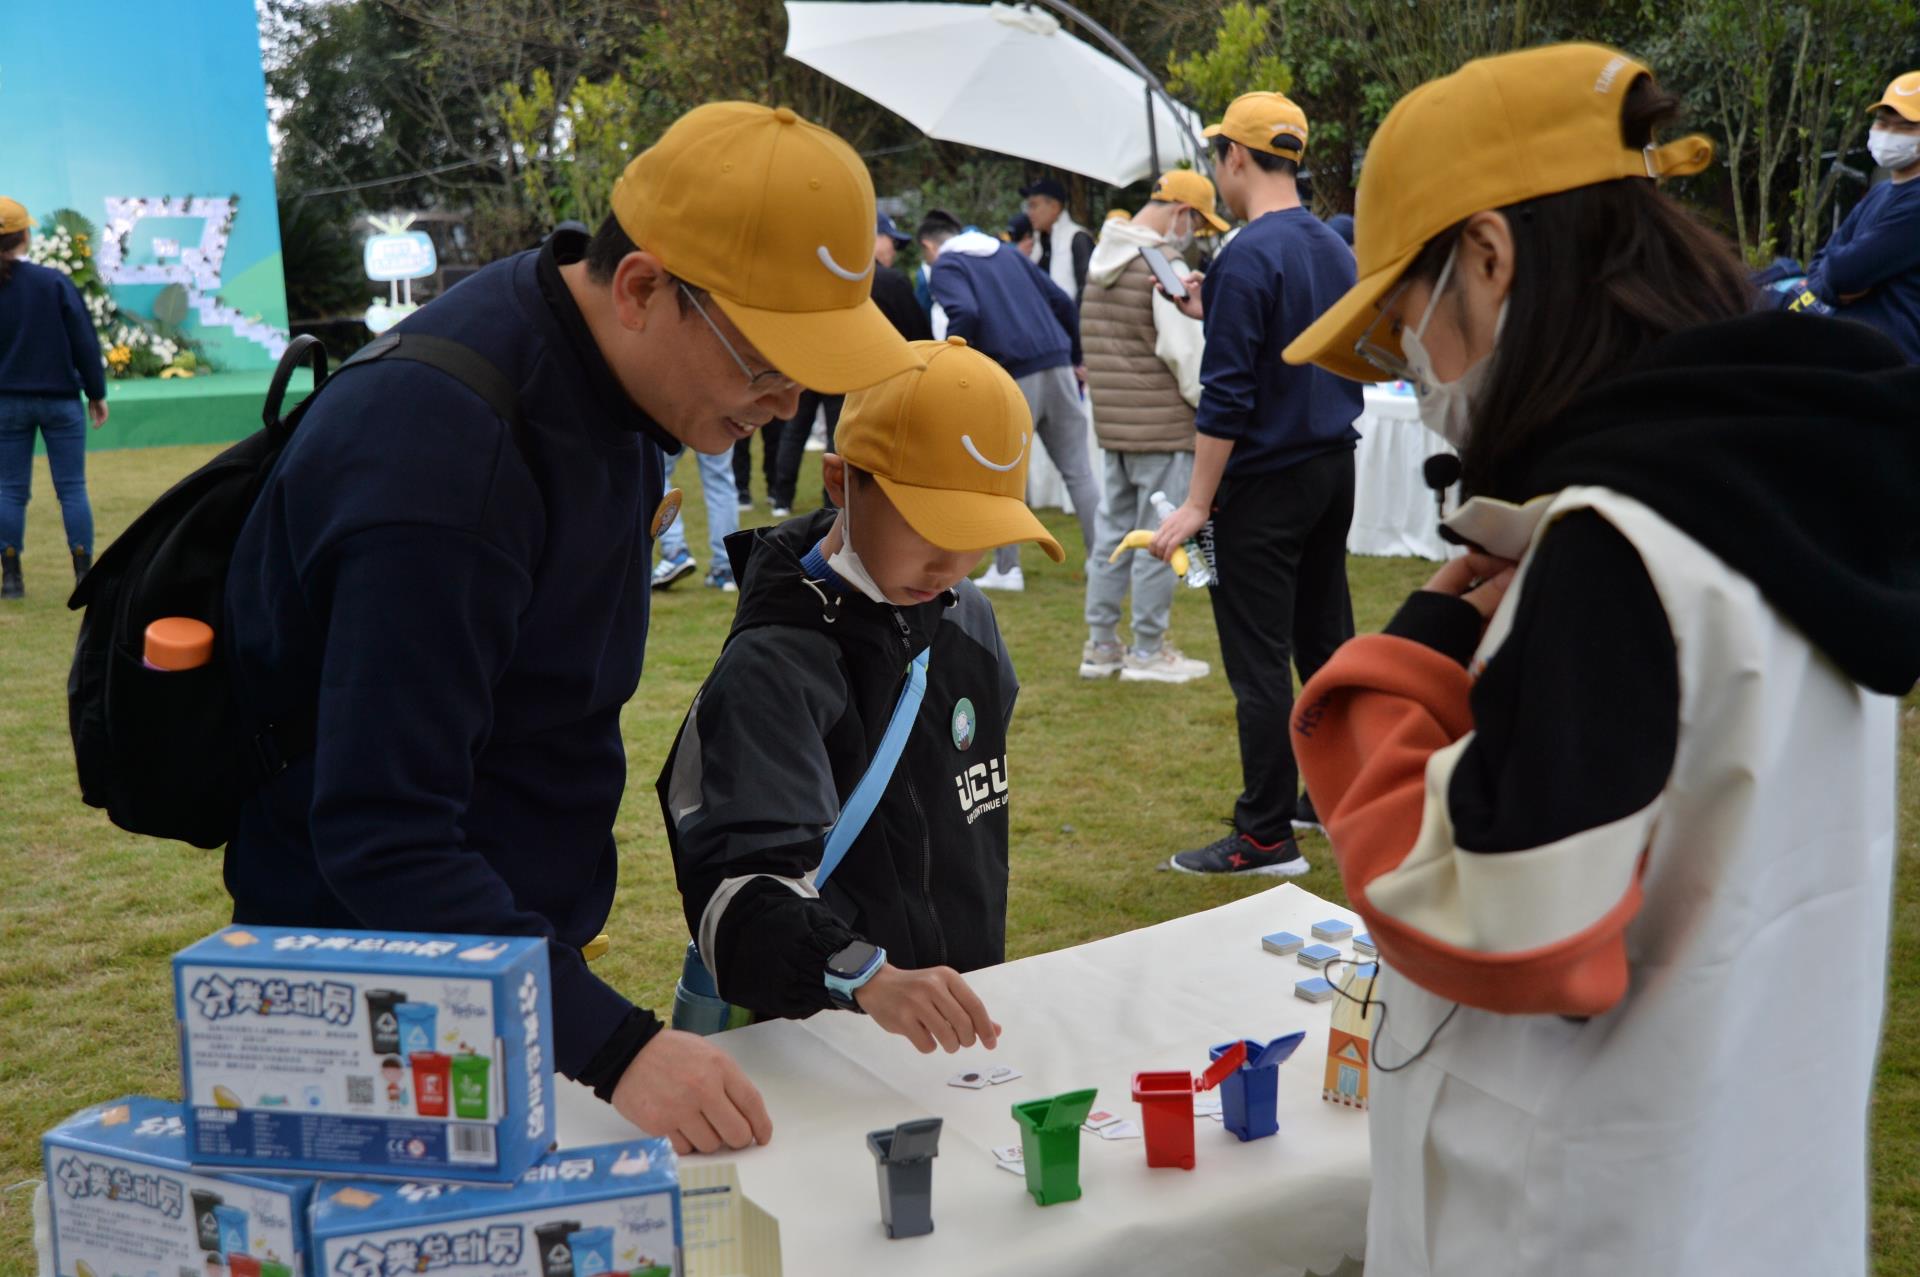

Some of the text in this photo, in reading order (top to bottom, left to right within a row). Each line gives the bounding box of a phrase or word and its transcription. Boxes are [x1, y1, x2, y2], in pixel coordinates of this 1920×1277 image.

[191, 973, 356, 1026] 分类总动员
[57, 1156, 184, 1220] 分类总动员
